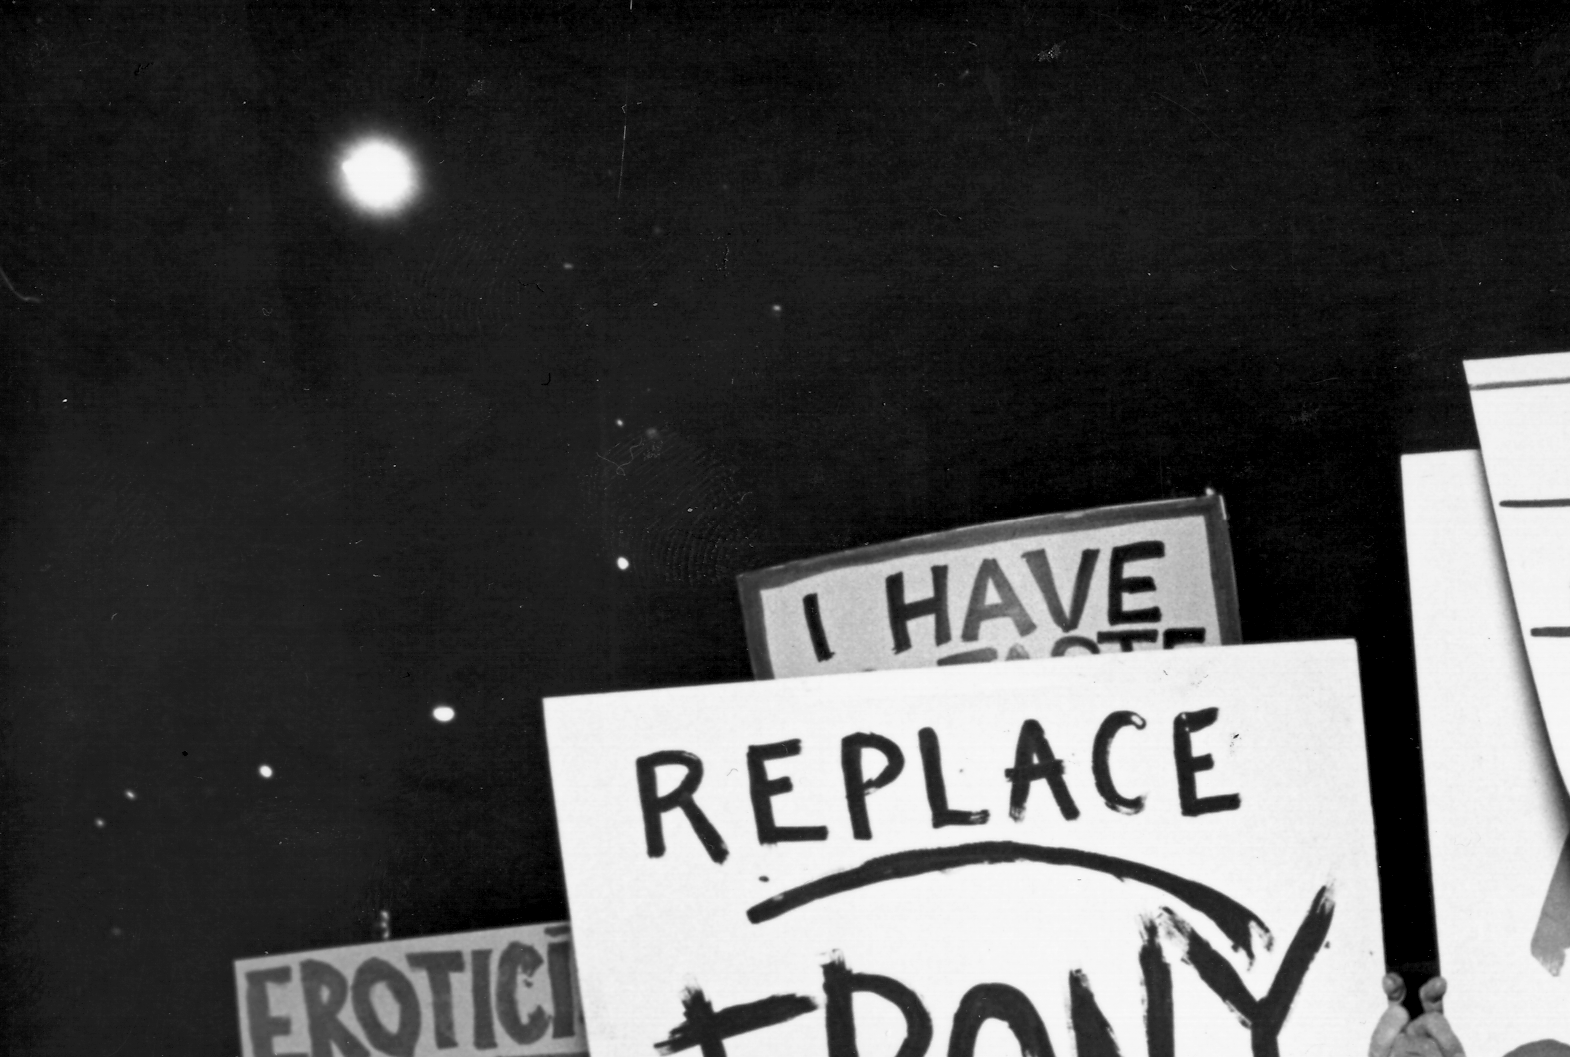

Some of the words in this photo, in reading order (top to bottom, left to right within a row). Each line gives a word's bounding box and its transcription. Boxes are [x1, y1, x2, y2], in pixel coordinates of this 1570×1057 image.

[802, 592, 835, 662] I
[885, 540, 1166, 655] HAVE
[635, 706, 1242, 864] REPLACE
